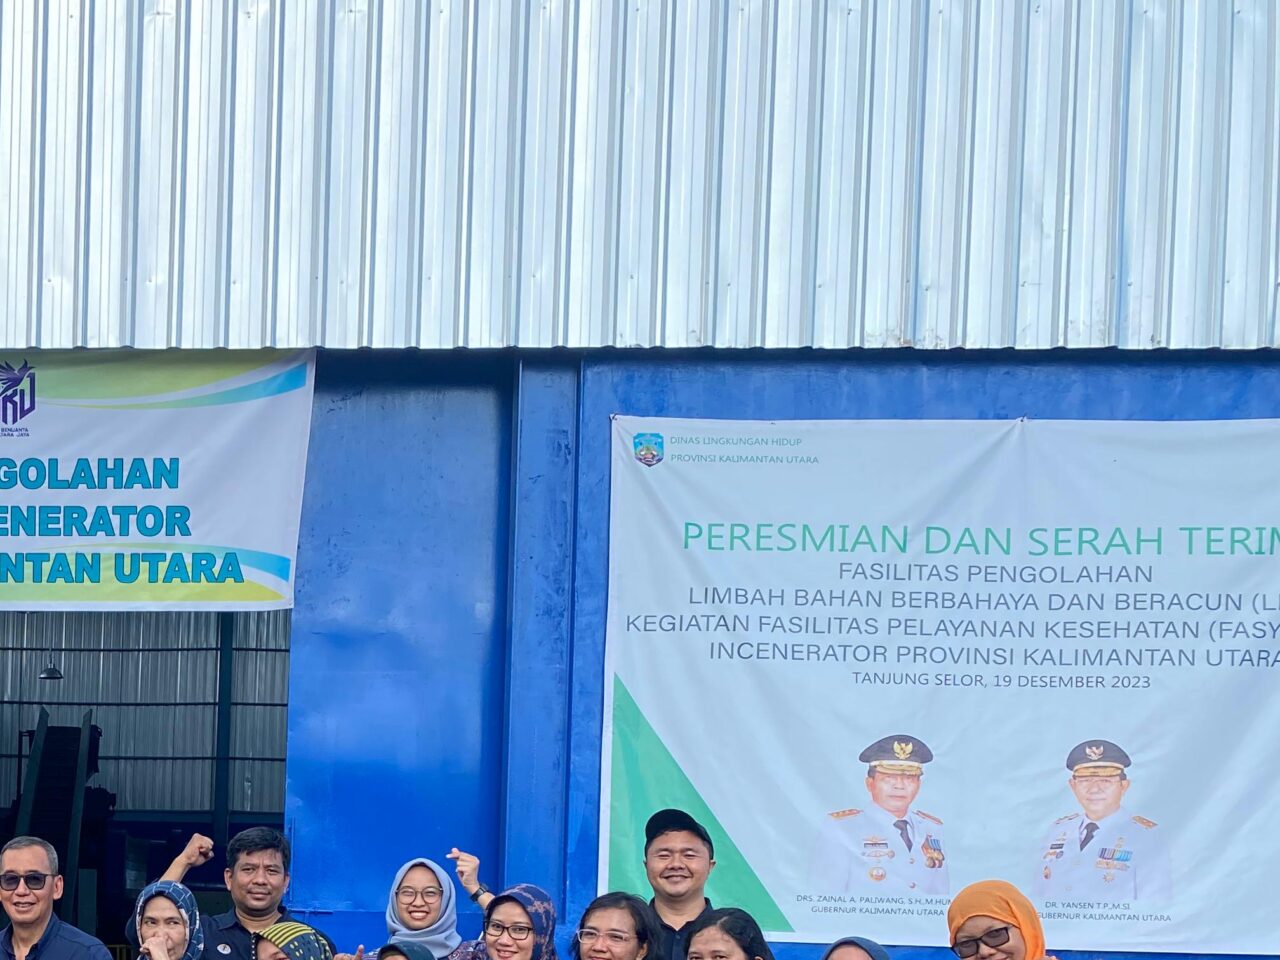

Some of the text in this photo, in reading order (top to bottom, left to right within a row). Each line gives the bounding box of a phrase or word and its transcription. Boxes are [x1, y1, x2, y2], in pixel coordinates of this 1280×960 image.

[670, 437, 802, 446] DINAS LINGKUNGAN HIDUP
[671, 454, 819, 464] PROVINSI KALIMANTAN UTARA
[684, 522, 907, 553] PERESMIAN
[926, 527, 1010, 555] DAN
[1029, 527, 1161, 556] SERAH
[114, 552, 244, 583] UTARA
[840, 563, 1152, 583] FASILITAS PENGOLAHAN
[690, 587, 784, 605] LIMBAH
[795, 589, 881, 607] BAHAN
[892, 591, 1039, 610] BERBAHAYA
[1049, 594, 1104, 610] DAN
[1116, 593, 1242, 610] BERACUN
[627, 615, 748, 631] KEGIATAN
[760, 616, 879, 635] FASILITAS
[887, 619, 1034, 637] PELAYANAN
[1045, 621, 1199, 638] KESEHATAN
[711, 642, 887, 662] INCENERATOR
[897, 646, 1013, 665] PROVINSI
[1024, 649, 1195, 666] KALIMANTAN
[853, 672, 1150, 688] TANJUNG SELOR, 19 DESEMBER 2023
[811, 906, 856, 914] GUBERNUR
[859, 907, 914, 915] KALIMANTAN
[1083, 913, 1139, 921] KALIMANTAN
